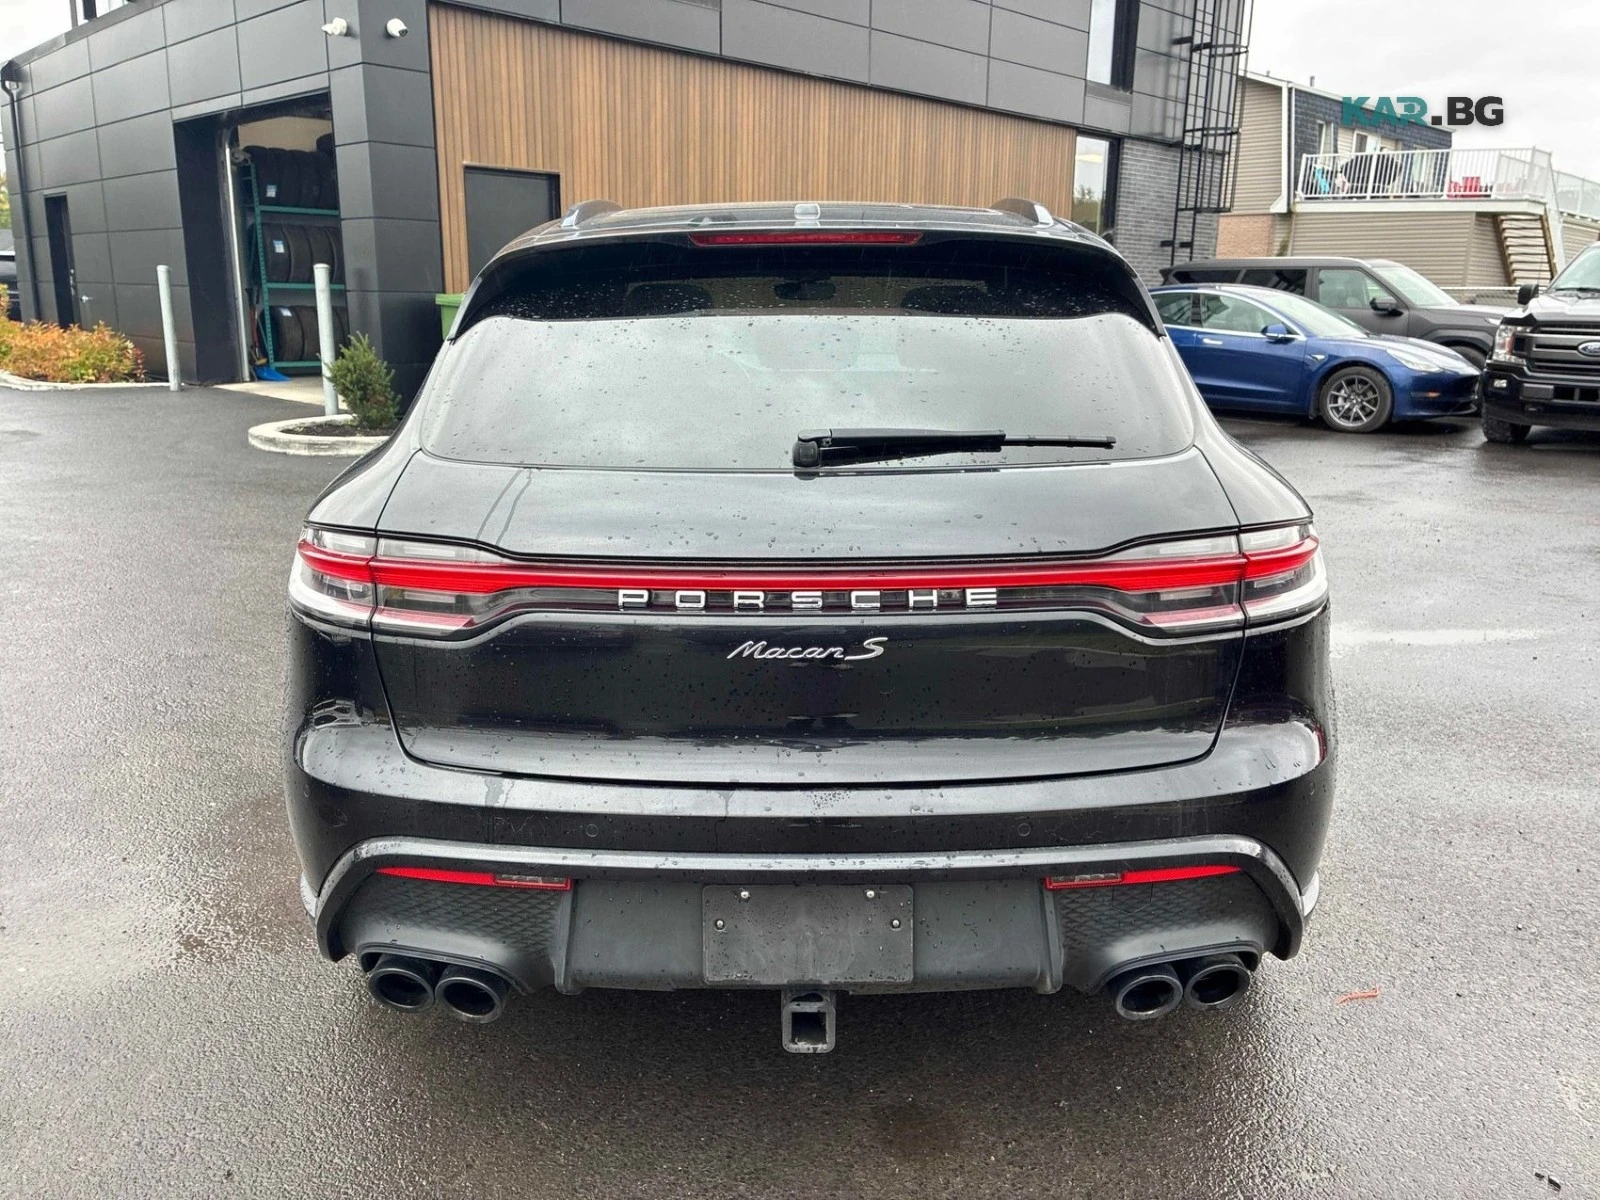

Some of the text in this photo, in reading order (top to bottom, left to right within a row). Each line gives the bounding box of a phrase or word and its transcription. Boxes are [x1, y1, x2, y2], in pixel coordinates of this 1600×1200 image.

[618, 588, 998, 611] PORSCHE
[727, 637, 888, 660] Macan S
